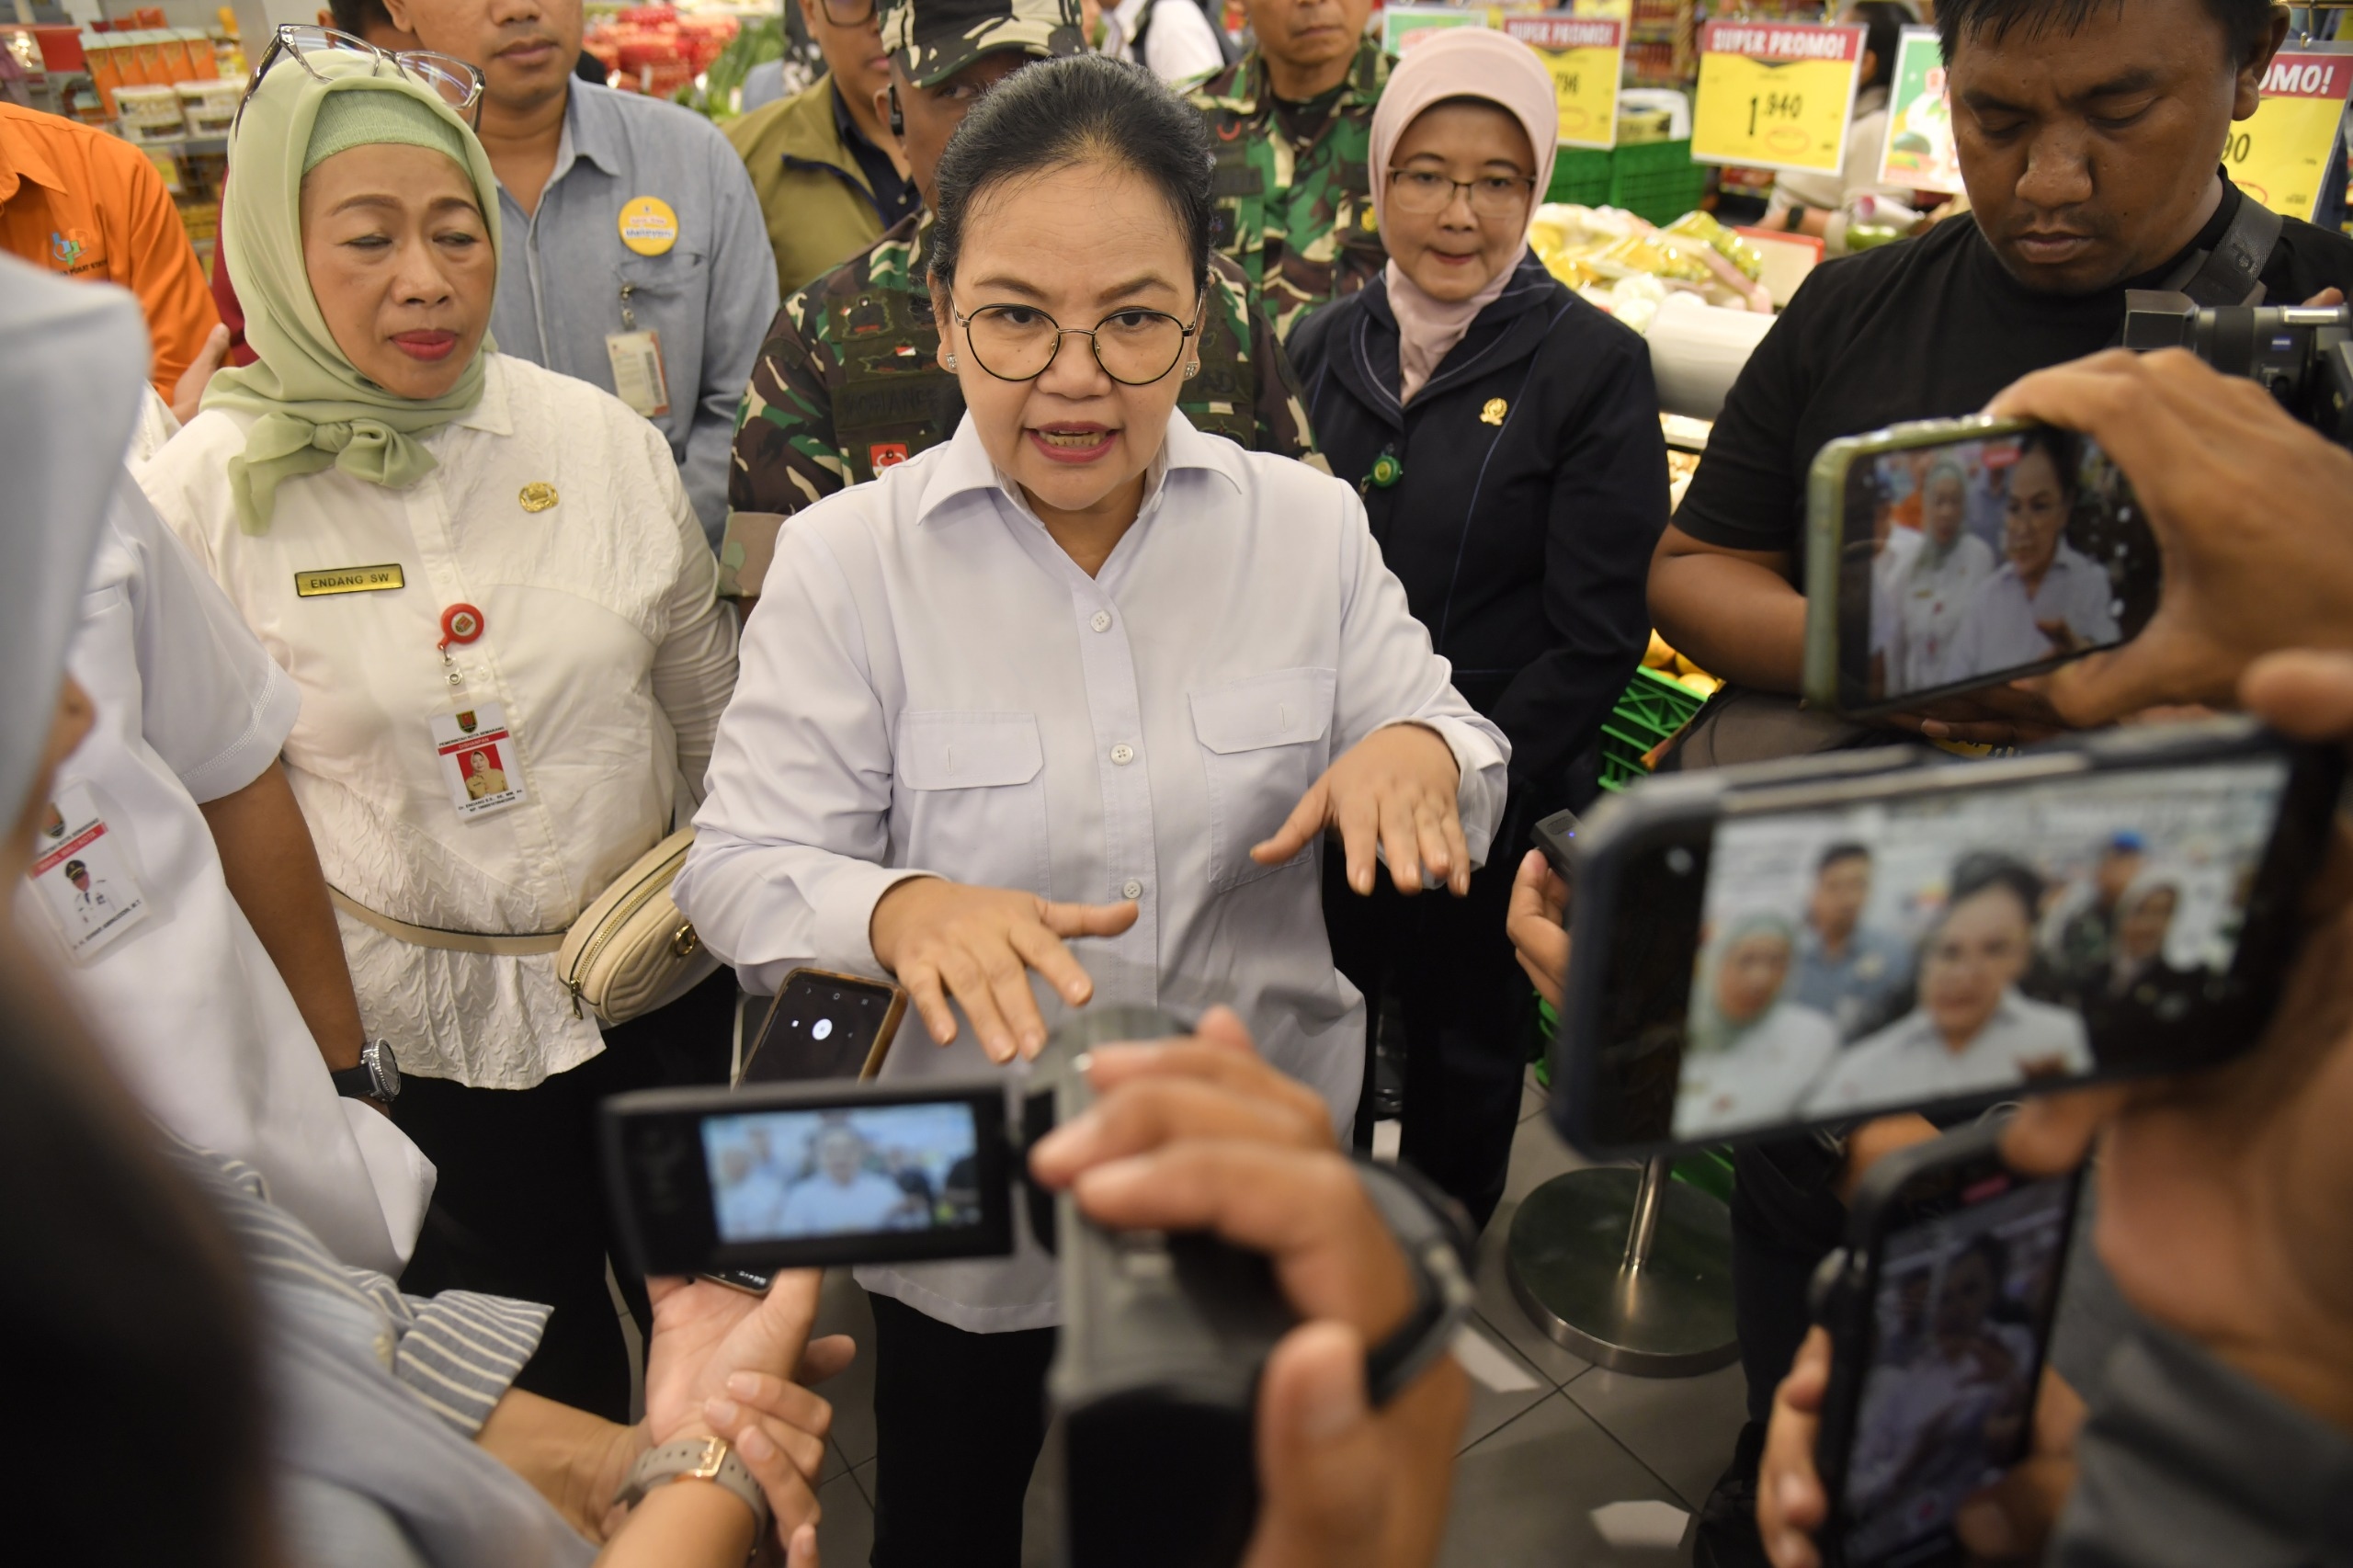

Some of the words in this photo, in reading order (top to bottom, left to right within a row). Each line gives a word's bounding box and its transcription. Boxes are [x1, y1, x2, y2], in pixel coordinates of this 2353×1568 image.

[1712, 28, 1767, 53] SUPER
[1768, 30, 1847, 59] PROMO!
[311, 575, 364, 588] ENDANG
[369, 573, 390, 583] SW
